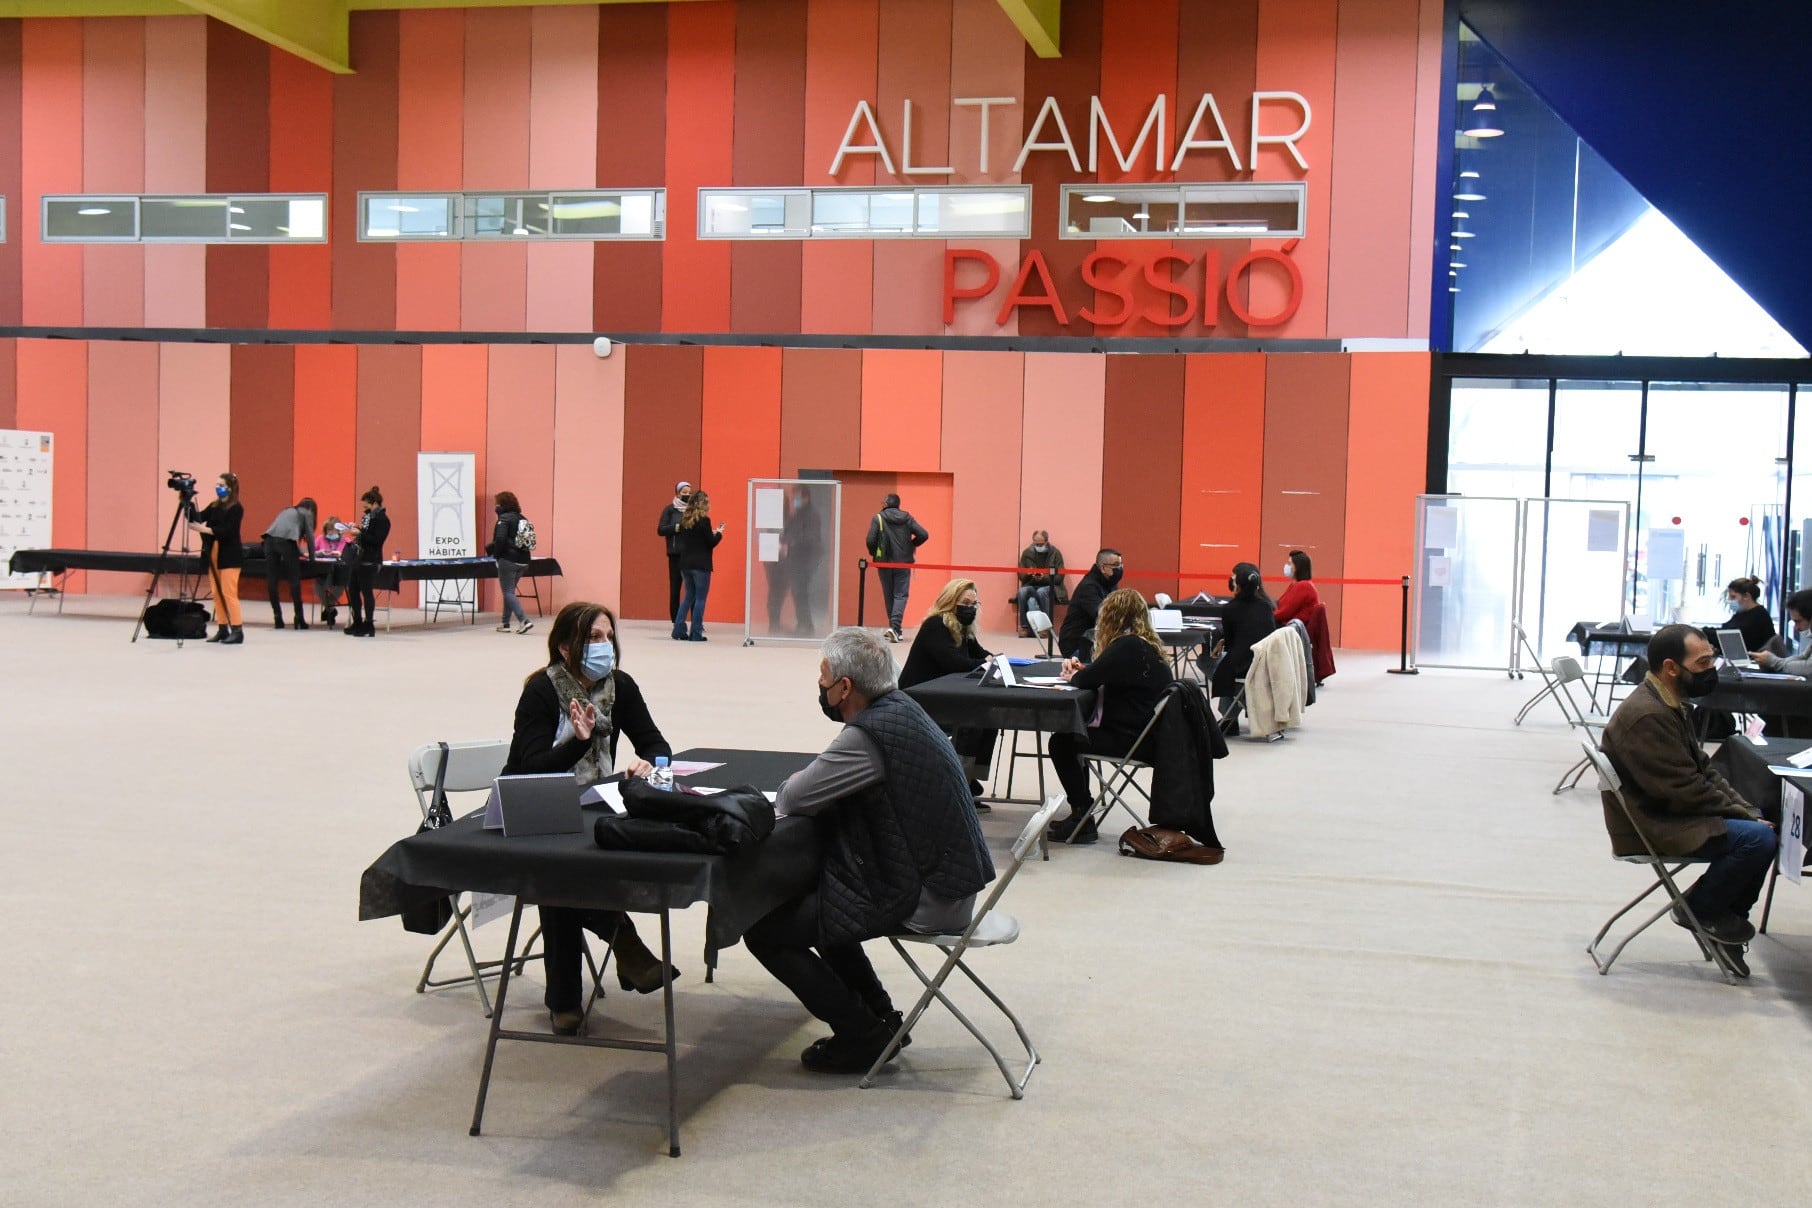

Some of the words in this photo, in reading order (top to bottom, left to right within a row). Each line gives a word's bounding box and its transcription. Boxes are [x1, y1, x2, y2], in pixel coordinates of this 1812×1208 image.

[829, 91, 1312, 175] ALTAMAR
[943, 238, 1304, 327] PASSIÓ
[435, 536, 460, 545] EXPO
